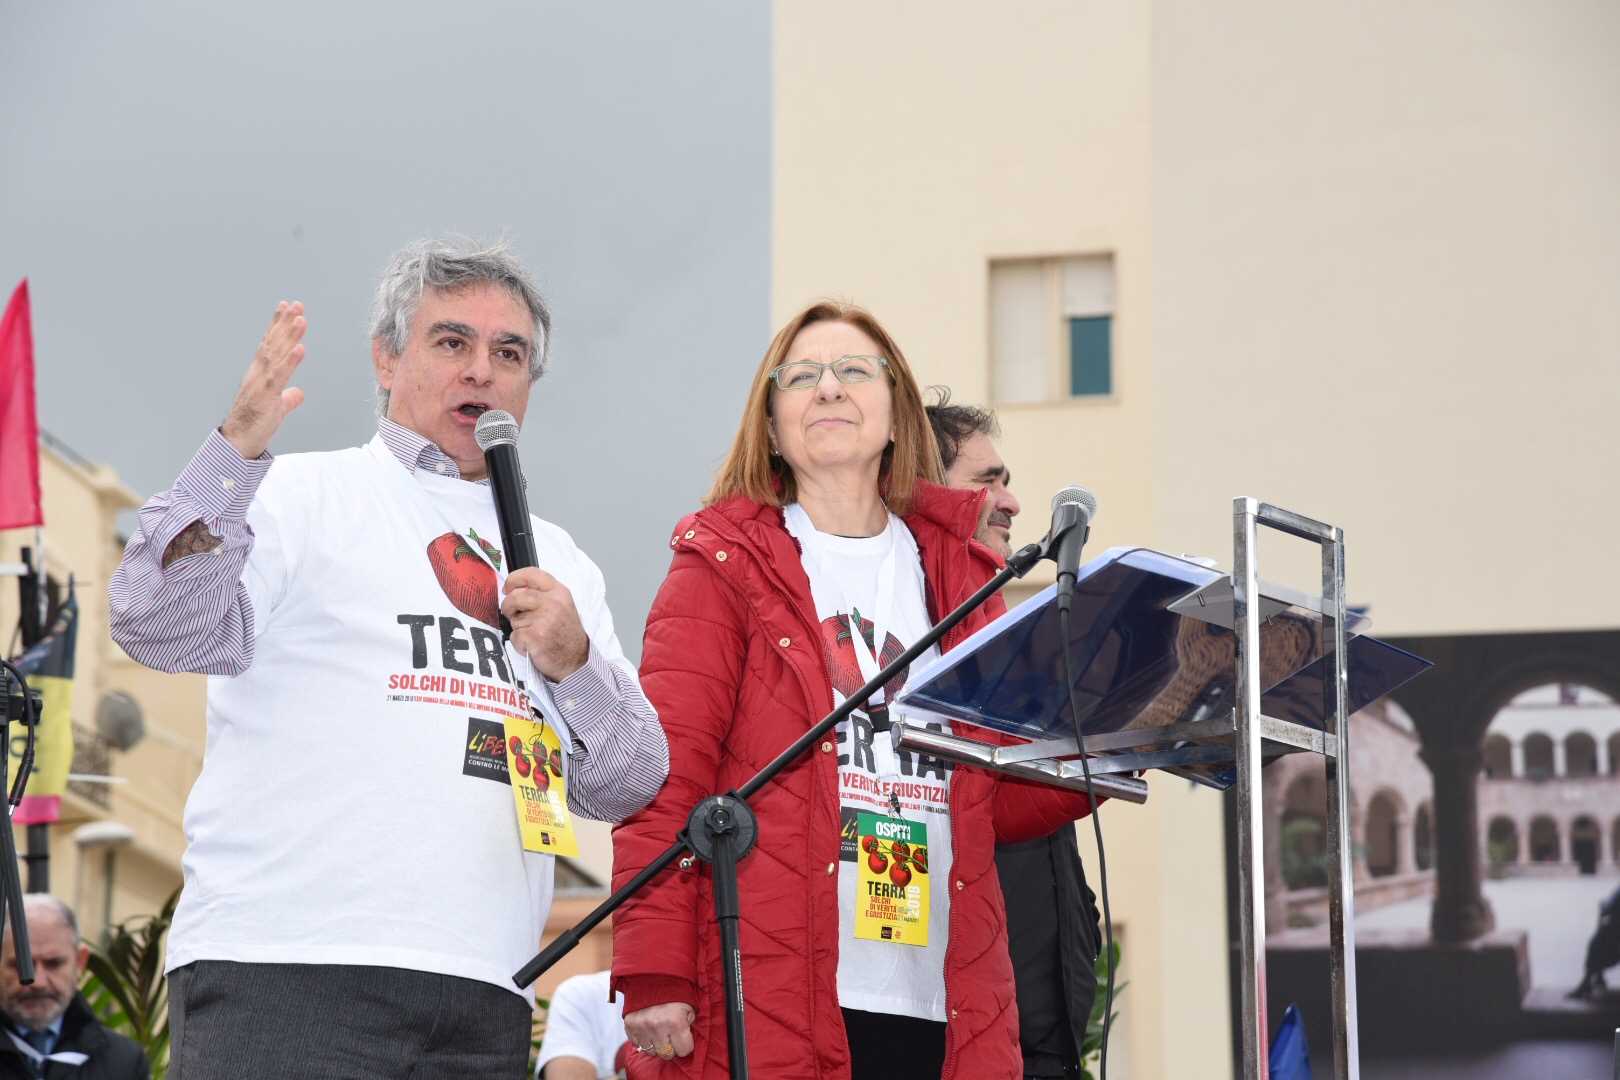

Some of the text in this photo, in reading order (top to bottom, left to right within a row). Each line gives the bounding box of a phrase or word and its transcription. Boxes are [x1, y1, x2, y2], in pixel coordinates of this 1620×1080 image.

[396, 613, 526, 691] TER
[388, 674, 446, 692] SOLCHI
[449, 677, 465, 695] DI
[468, 759, 493, 769] CONTRO
[882, 781, 890, 797] E
[875, 821, 911, 841] OSPITI
[867, 880, 906, 900] TERRA
